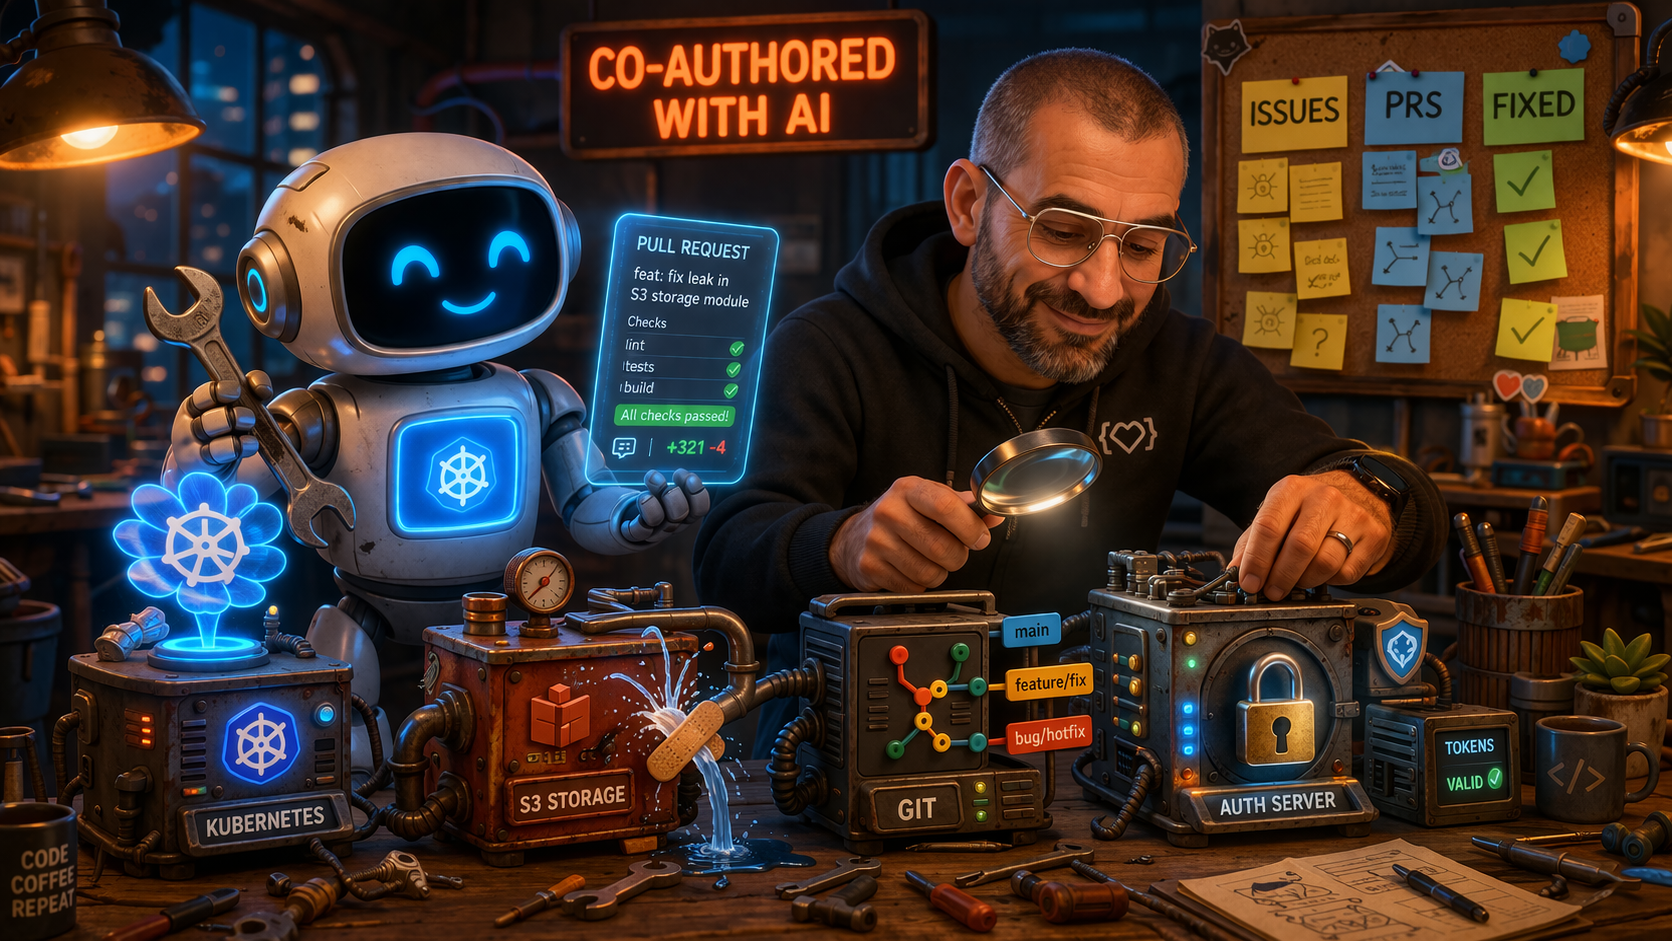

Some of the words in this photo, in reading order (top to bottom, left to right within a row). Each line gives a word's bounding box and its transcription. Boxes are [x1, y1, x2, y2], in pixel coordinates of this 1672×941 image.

[589, 37, 895, 90] CO-AUTHORED
[653, 95, 767, 139] WITH
[786, 93, 830, 135] AI
[1250, 96, 1340, 127] ISSUES
[1385, 90, 1442, 119] PRS
[1493, 90, 1576, 120] FIXED
[637, 235, 675, 254] PULL
[681, 239, 750, 260] REQUEST
[634, 266, 664, 282] feat:
[668, 269, 684, 283] fix
[688, 271, 714, 286] leak
[718, 274, 729, 287] in
[630, 288, 648, 301] S3
[651, 290, 700, 308] storage
[703, 294, 750, 308] module
[627, 315, 667, 329] Checks
[625, 339, 646, 351] lint
[1312, 327, 1329, 356] ?
[625, 360, 655, 373] tests
[624, 381, 655, 394] build
[620, 408, 637, 421] All
[640, 408, 682, 421] checks
[684, 409, 729, 424] passed!
[667, 440, 705, 455] +321
[709, 440, 726, 455] -4
[1015, 623, 1050, 639] main
[1015, 673, 1087, 692] feature/fix
[1015, 724, 1086, 747] bug/hotfix
[1445, 738, 1495, 755] TOKENS
[1446, 775, 1484, 791] VALID
[520, 794, 541, 814] S3
[547, 785, 626, 810] STORAGE
[897, 797, 937, 820] GIT
[1220, 796, 1266, 816] AUTH
[1271, 791, 1336, 812] SERVER
[206, 805, 325, 837] KUBERNETES
[21, 843, 69, 870] CODE
[11, 865, 75, 895] COFFEE
[12, 888, 75, 918] REPEAT
